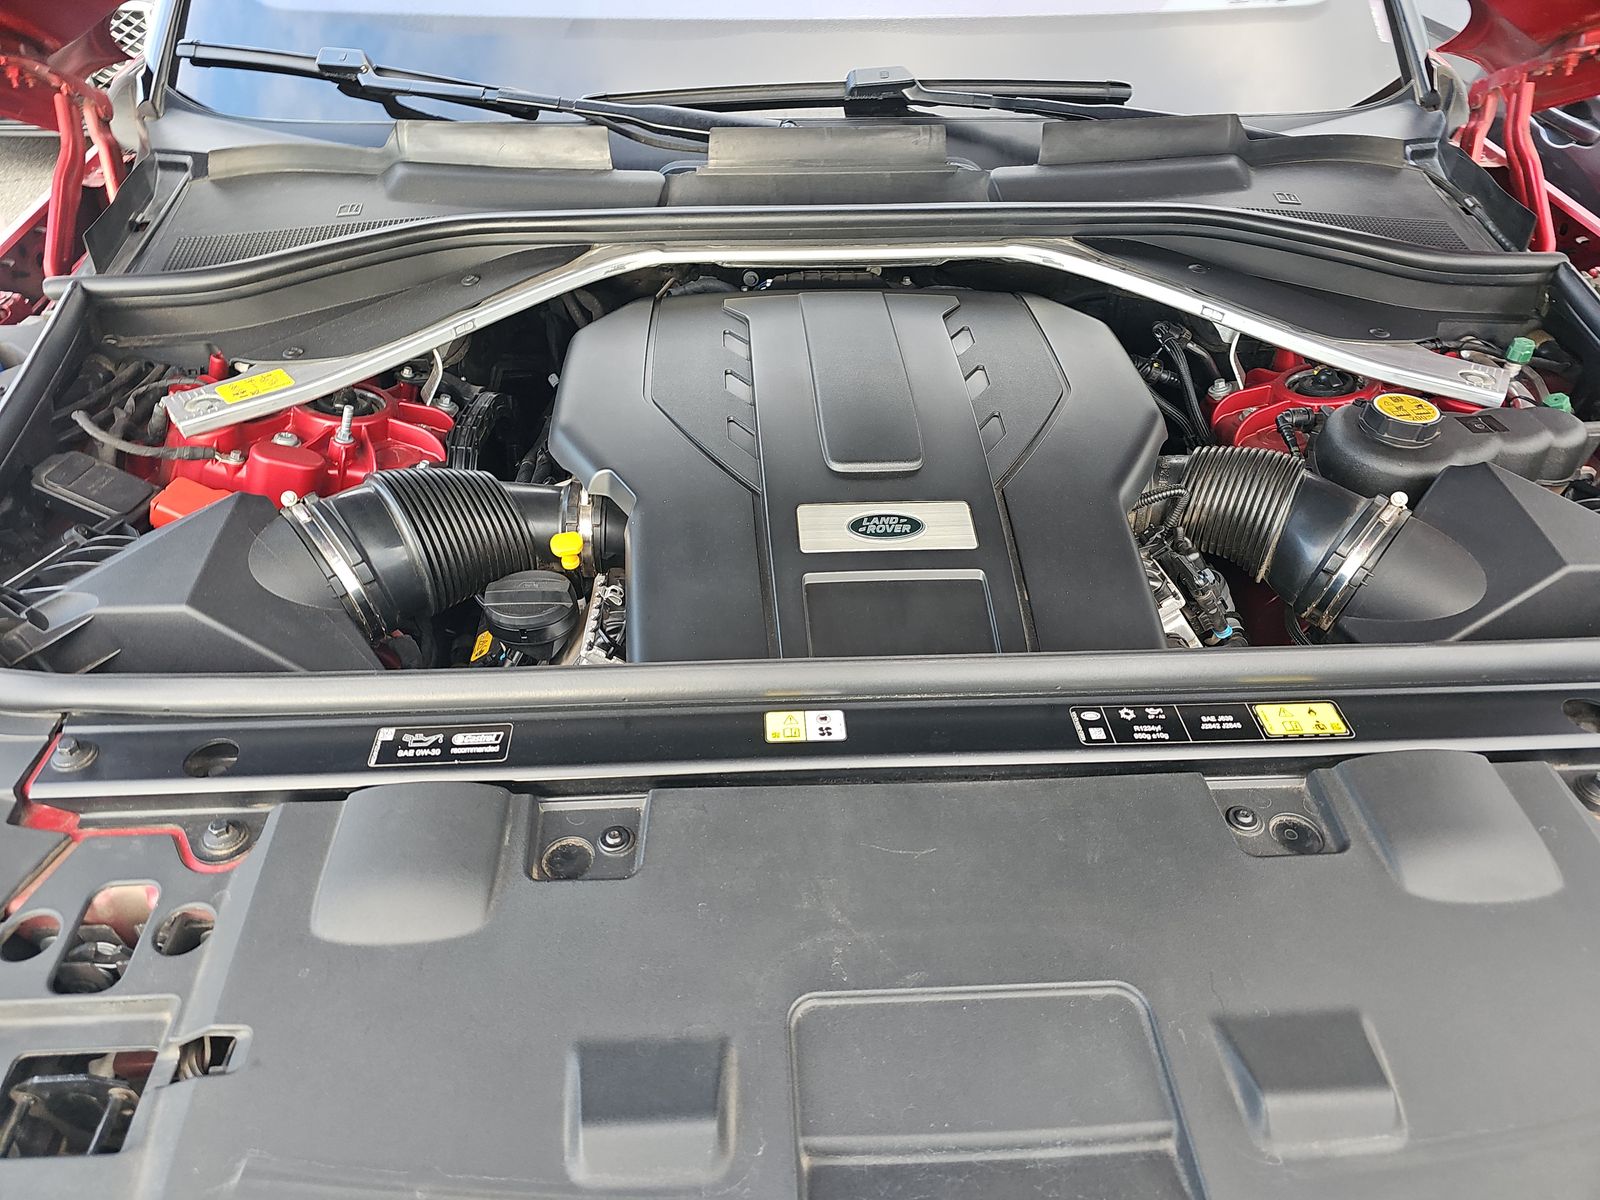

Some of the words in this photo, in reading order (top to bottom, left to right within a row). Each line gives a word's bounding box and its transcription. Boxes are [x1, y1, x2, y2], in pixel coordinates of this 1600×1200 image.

[862, 516, 899, 525] LAND
[866, 524, 911, 533] ROVER
[450, 745, 500, 754] recommended
